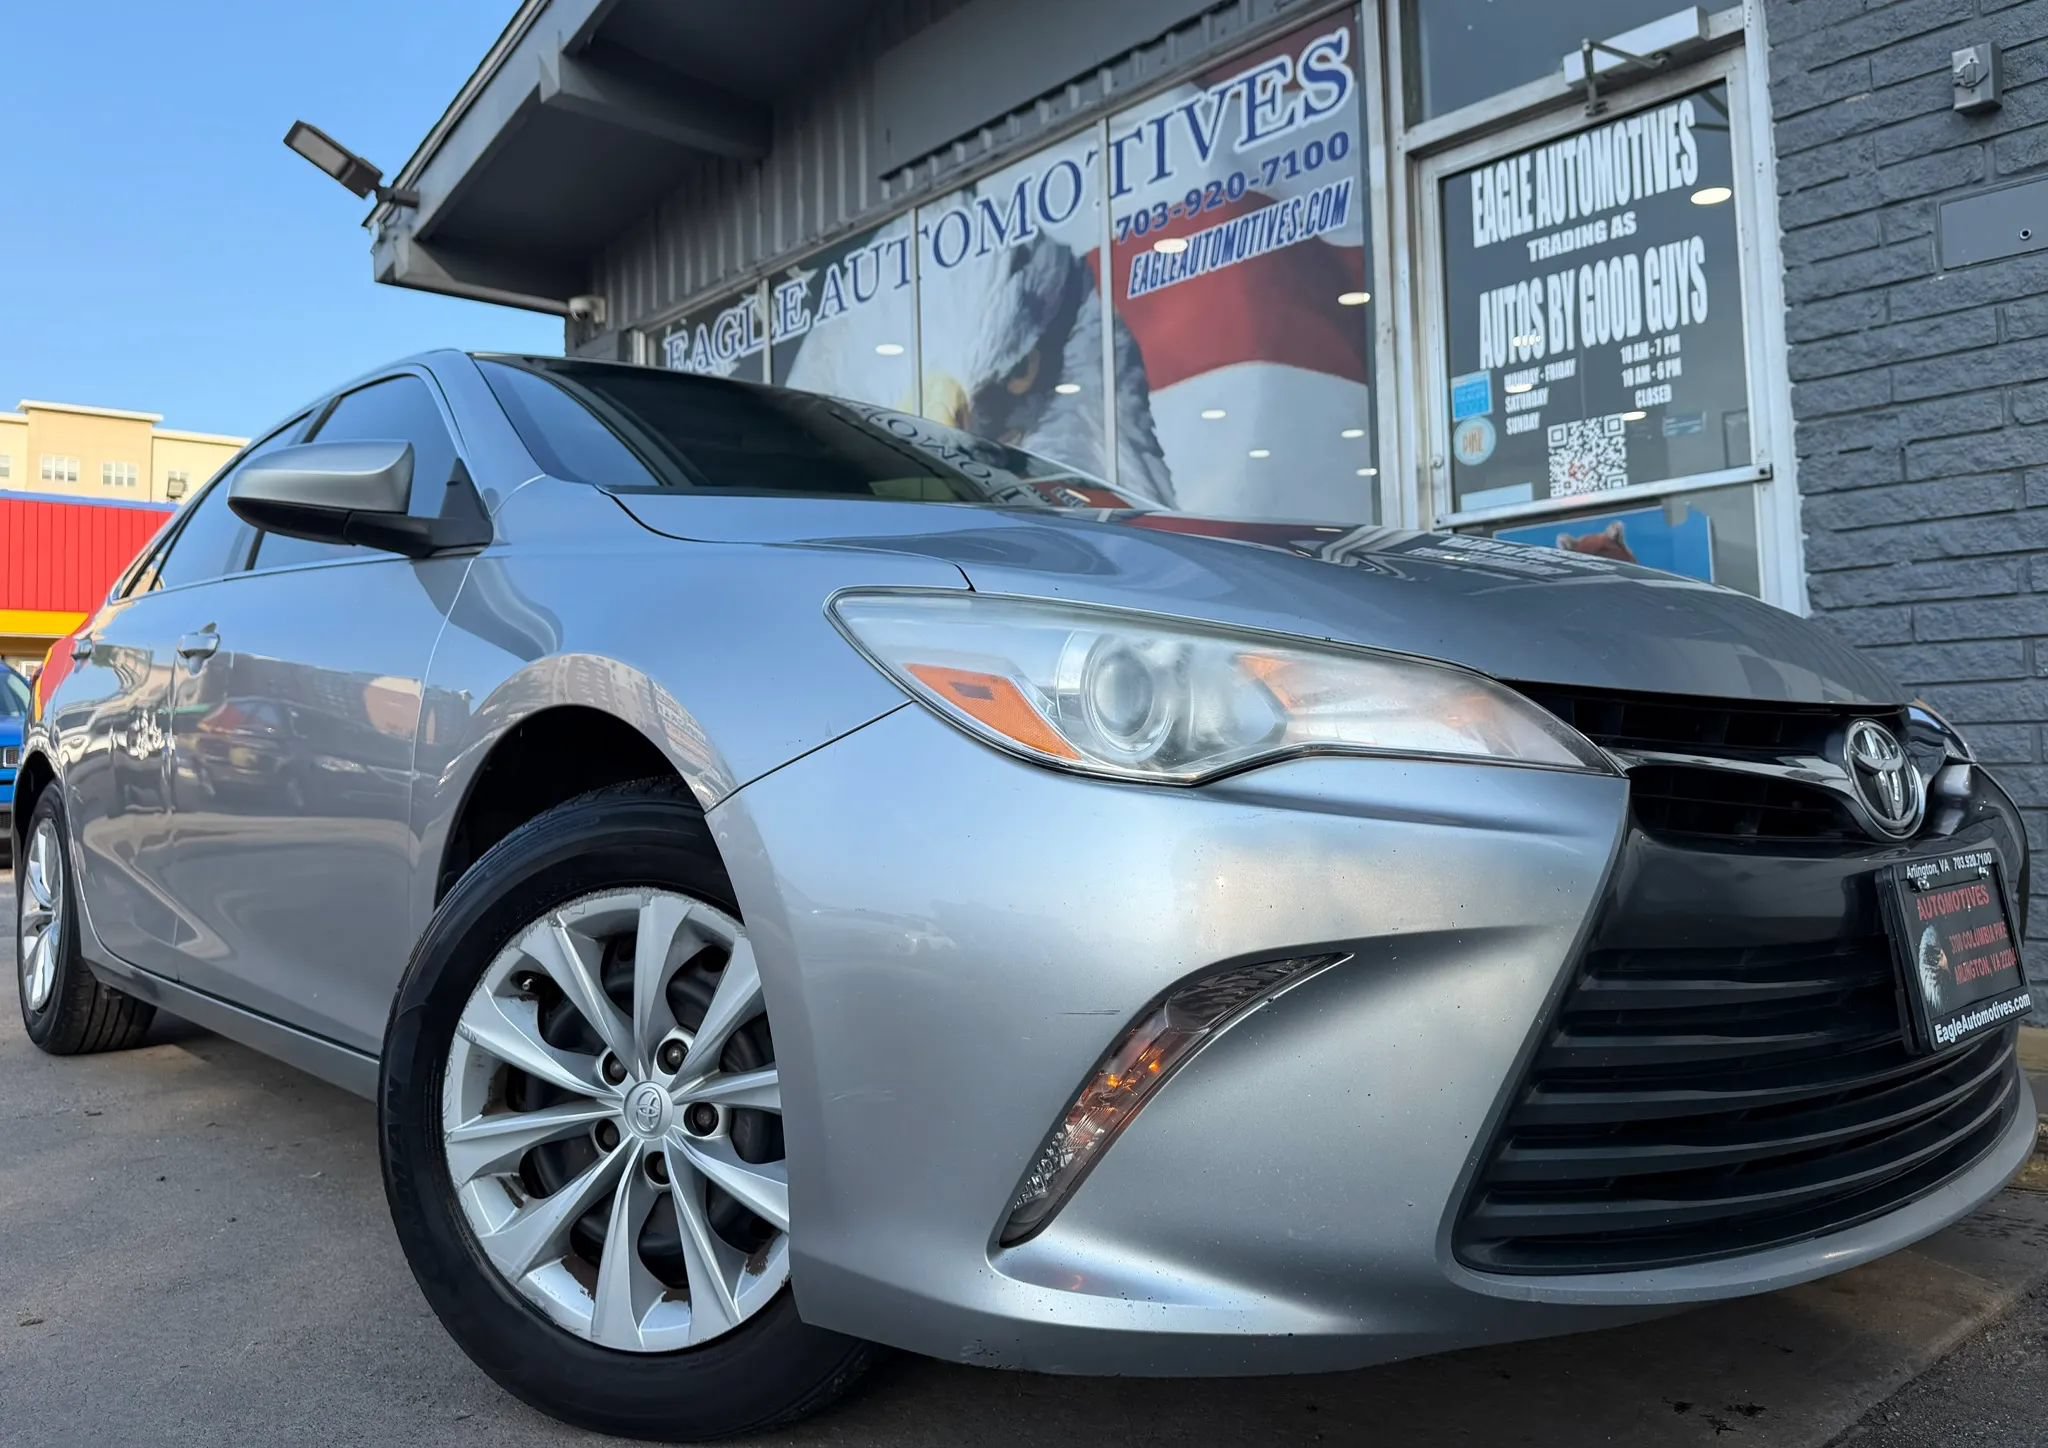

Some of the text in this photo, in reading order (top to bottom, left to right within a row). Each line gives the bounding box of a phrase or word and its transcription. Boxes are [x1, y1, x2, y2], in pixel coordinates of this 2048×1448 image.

[1116, 131, 1349, 244] 703-920-7100
[1471, 99, 1698, 248] EAGLE AUTOMOTIVES
[664, 28, 1354, 371] EAGLE AUTOMOTIVES
[1127, 178, 1353, 298] EAGLEAUTOMOTIVES.COM
[1526, 211, 1637, 262] TRADING AS
[1479, 235, 1708, 370] AUTOS BY GOOD GUYS
[1634, 341, 1650, 362] AM
[1664, 334, 1682, 354] PM
[1545, 358, 1576, 382] FRIDAY
[1634, 364, 1651, 385] AM
[1665, 357, 1682, 378] PM
[1505, 388, 1549, 414] SATURDAY
[1635, 384, 1672, 408] CLOSED
[1506, 412, 1540, 436] SUNDAY
[1938, 858, 1950, 872] VA
[1917, 884, 1990, 921] AUTOMOTIVES
[1934, 993, 2031, 1044] EagleAutomotives.com
